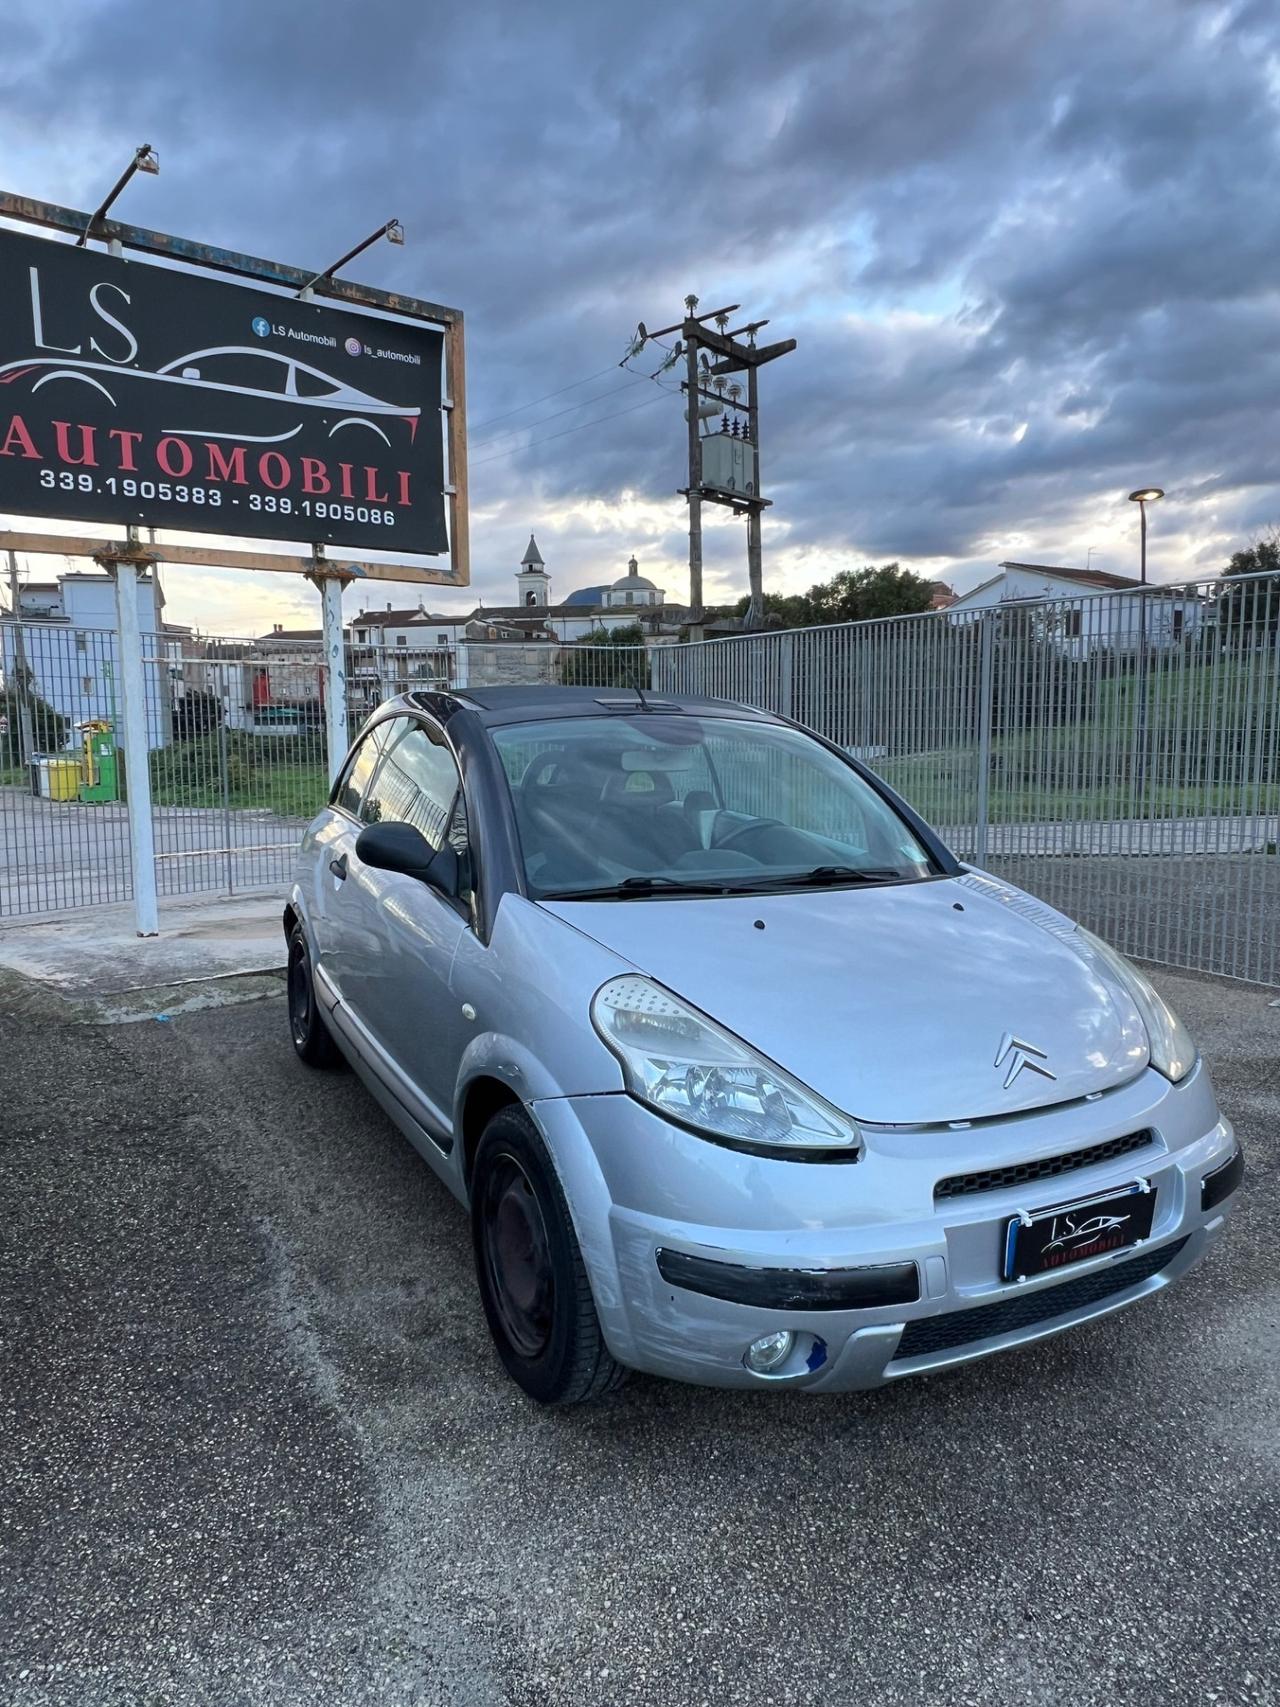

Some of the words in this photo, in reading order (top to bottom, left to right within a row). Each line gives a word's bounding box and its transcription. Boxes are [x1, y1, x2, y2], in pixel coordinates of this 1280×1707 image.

[29, 266, 138, 364] LS
[272, 325, 286, 336] LS
[287, 330, 337, 348] Automobili
[363, 345, 421, 365] ls_automobili
[0, 415, 412, 506] AUTOMOBILI
[40, 469, 222, 506] 339.1905383
[249, 494, 395, 525] 339.1905086
